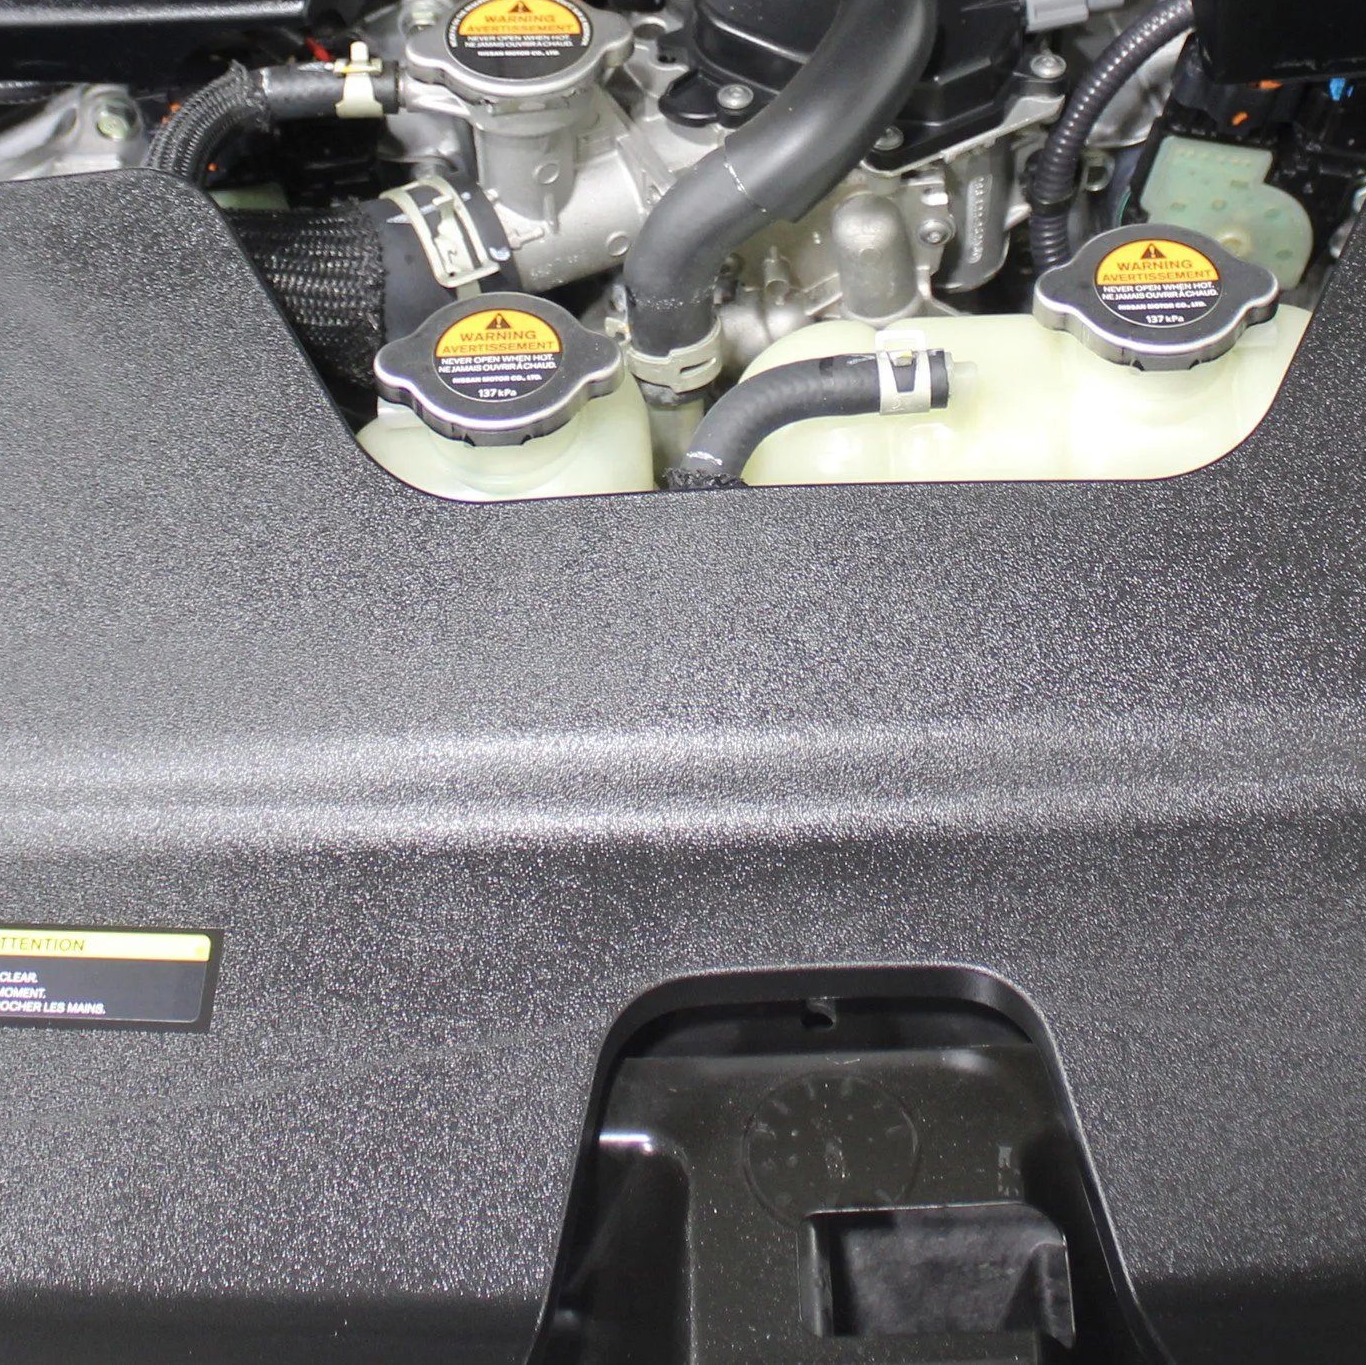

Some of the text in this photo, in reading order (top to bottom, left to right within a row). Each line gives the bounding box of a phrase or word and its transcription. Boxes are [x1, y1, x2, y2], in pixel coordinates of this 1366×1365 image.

[484, 15, 556, 23] WARNING
[466, 25, 574, 33] AVERTISSEMENT
[1116, 260, 1193, 271] WARNING
[1103, 270, 1212, 281] AVERTISSEMENT
[1115, 292, 1145, 300] JAMAIS
[1146, 291, 1178, 299] OUVRIR
[1146, 315, 1184, 323] 137 kPa
[460, 331, 537, 342] WARNING
[442, 342, 554, 353] AVERTISSEMENT
[441, 357, 472, 365] NEVER
[452, 365, 481, 373] JAMAIS
[478, 389, 517, 397] 137 kPa
[43, 1002, 65, 1013] LES
